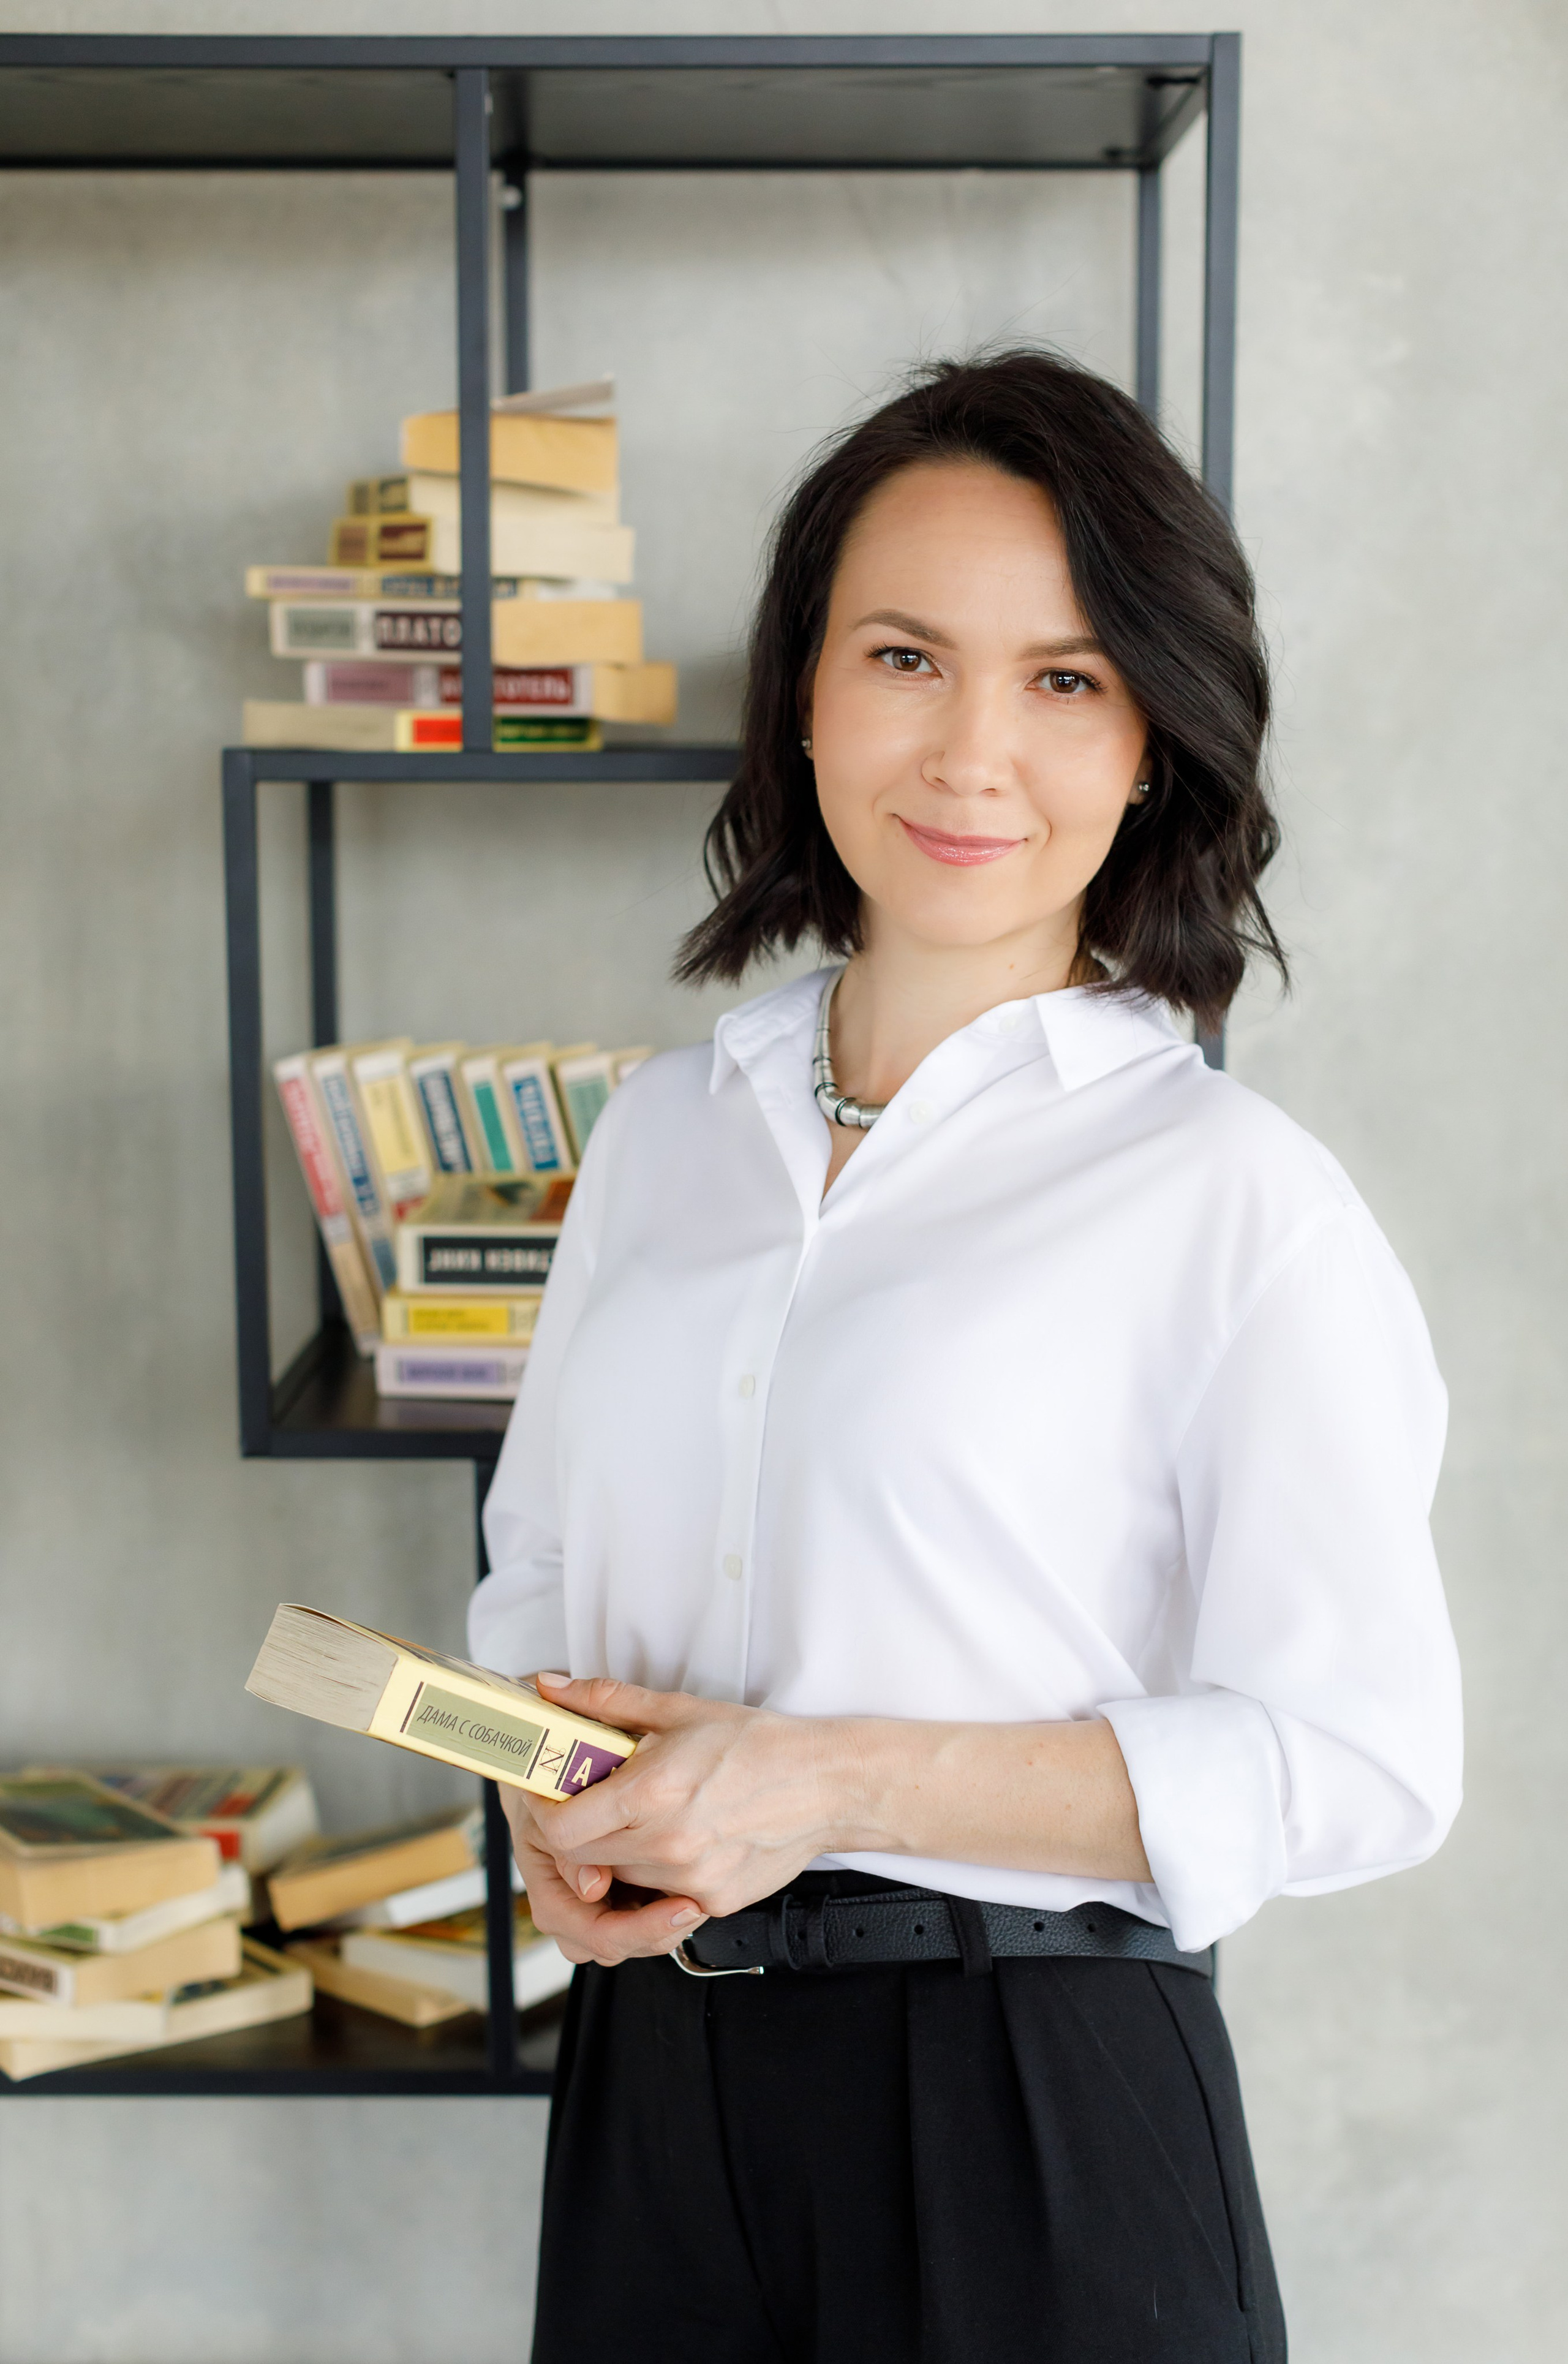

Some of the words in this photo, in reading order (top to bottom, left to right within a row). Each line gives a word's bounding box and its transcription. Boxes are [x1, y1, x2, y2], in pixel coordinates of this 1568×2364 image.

[377, 616, 464, 648] ПЛАТО
[417, 1705, 459, 1732] ДАМА
[459, 1719, 471, 1735] С
[469, 1723, 533, 1758] СОБАЧКОЙ
